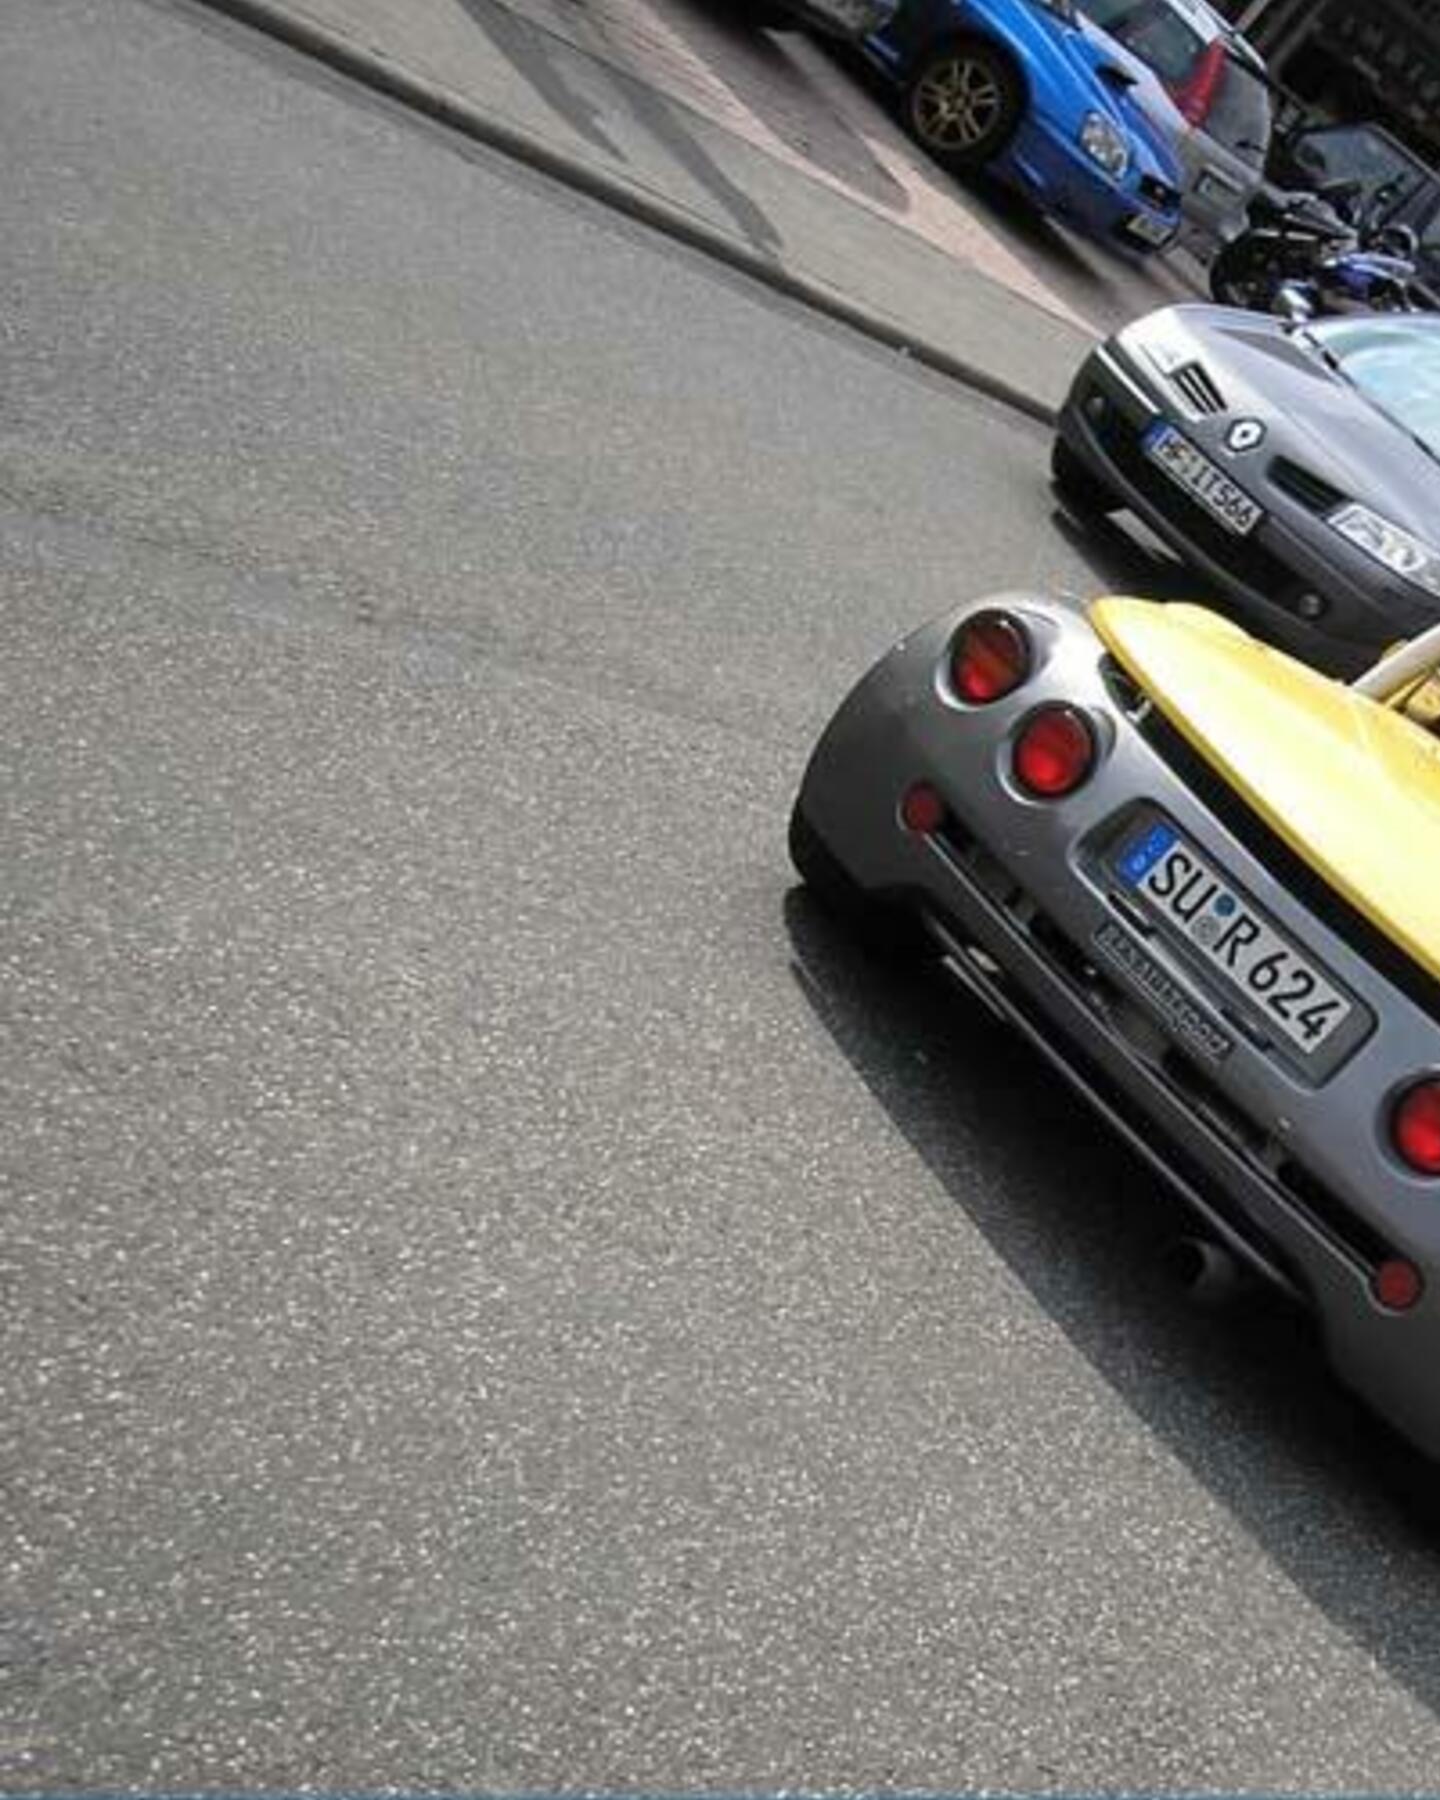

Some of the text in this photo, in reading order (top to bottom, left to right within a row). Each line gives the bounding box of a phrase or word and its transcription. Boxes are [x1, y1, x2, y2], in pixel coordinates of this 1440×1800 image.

[1149, 853, 1341, 1041] SU R 624
